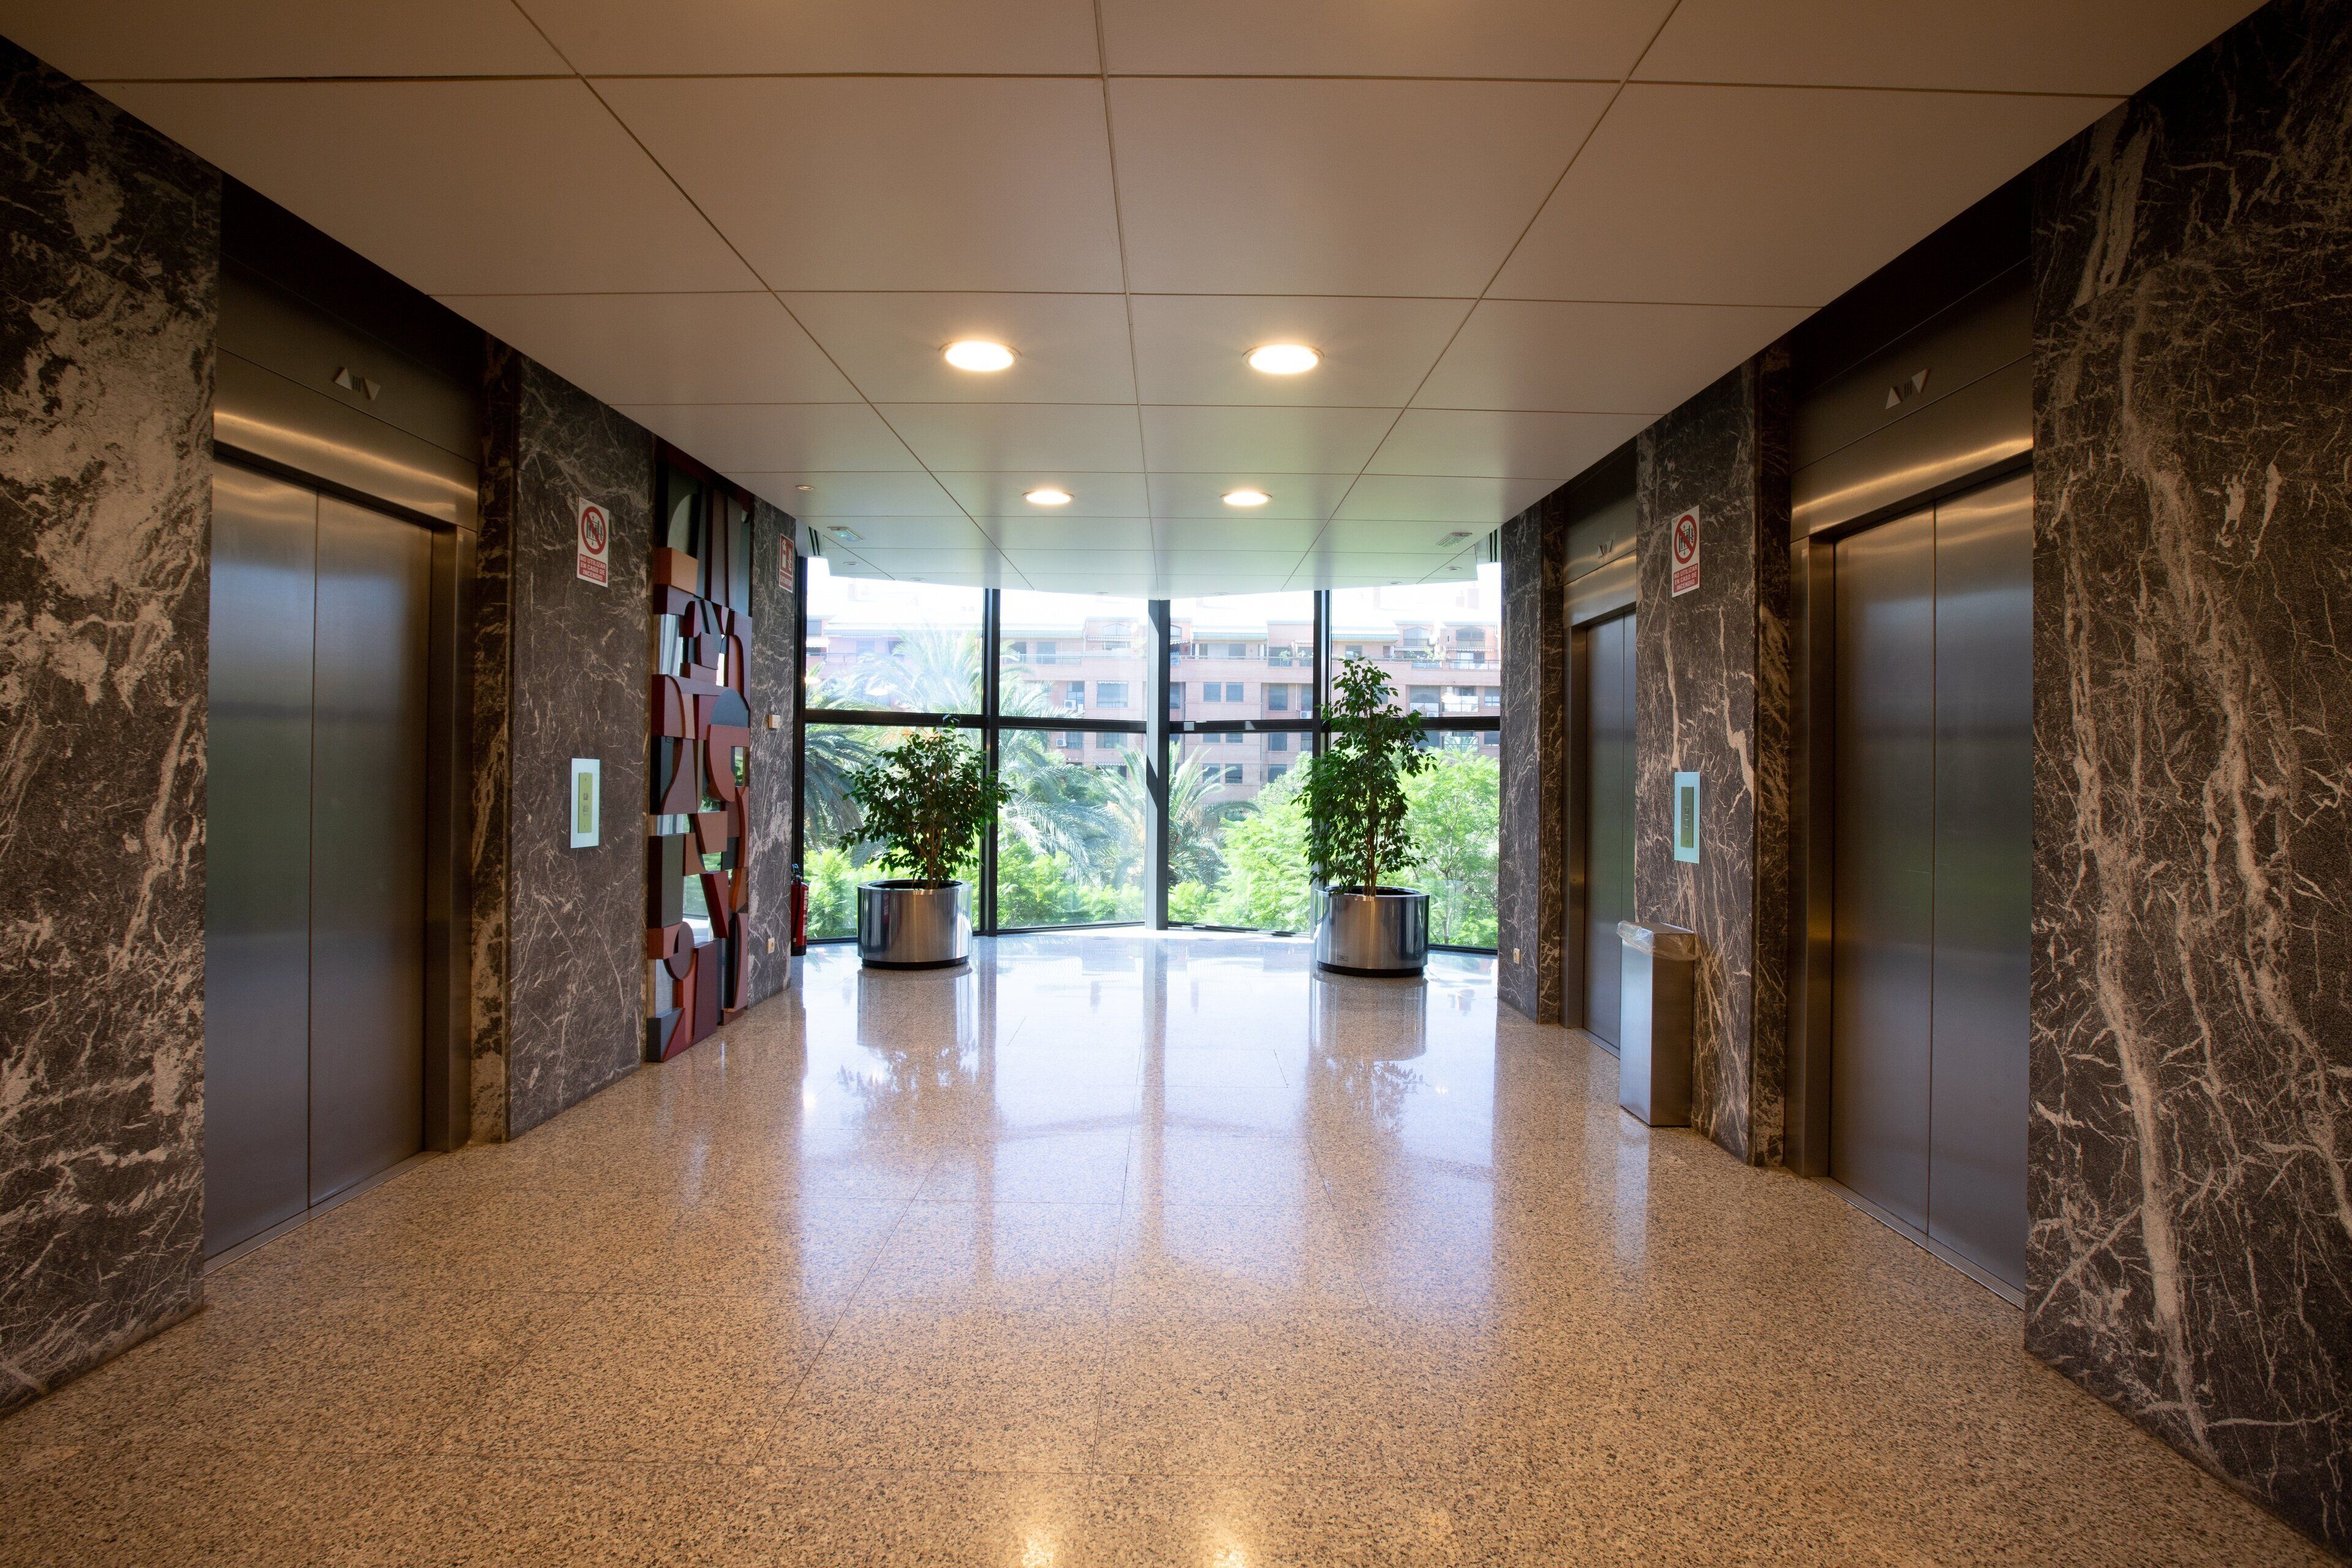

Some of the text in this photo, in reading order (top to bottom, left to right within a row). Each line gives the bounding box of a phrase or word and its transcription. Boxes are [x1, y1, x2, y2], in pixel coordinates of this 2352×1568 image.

[587, 557, 606, 570] UTILIZAR
[587, 564, 598, 573] CASO
[583, 569, 603, 581] INCENDIO
[1680, 565, 1697, 576] UTILIZAR
[1680, 574, 1691, 582] CASO
[1676, 579, 1695, 590] INCENDIO
